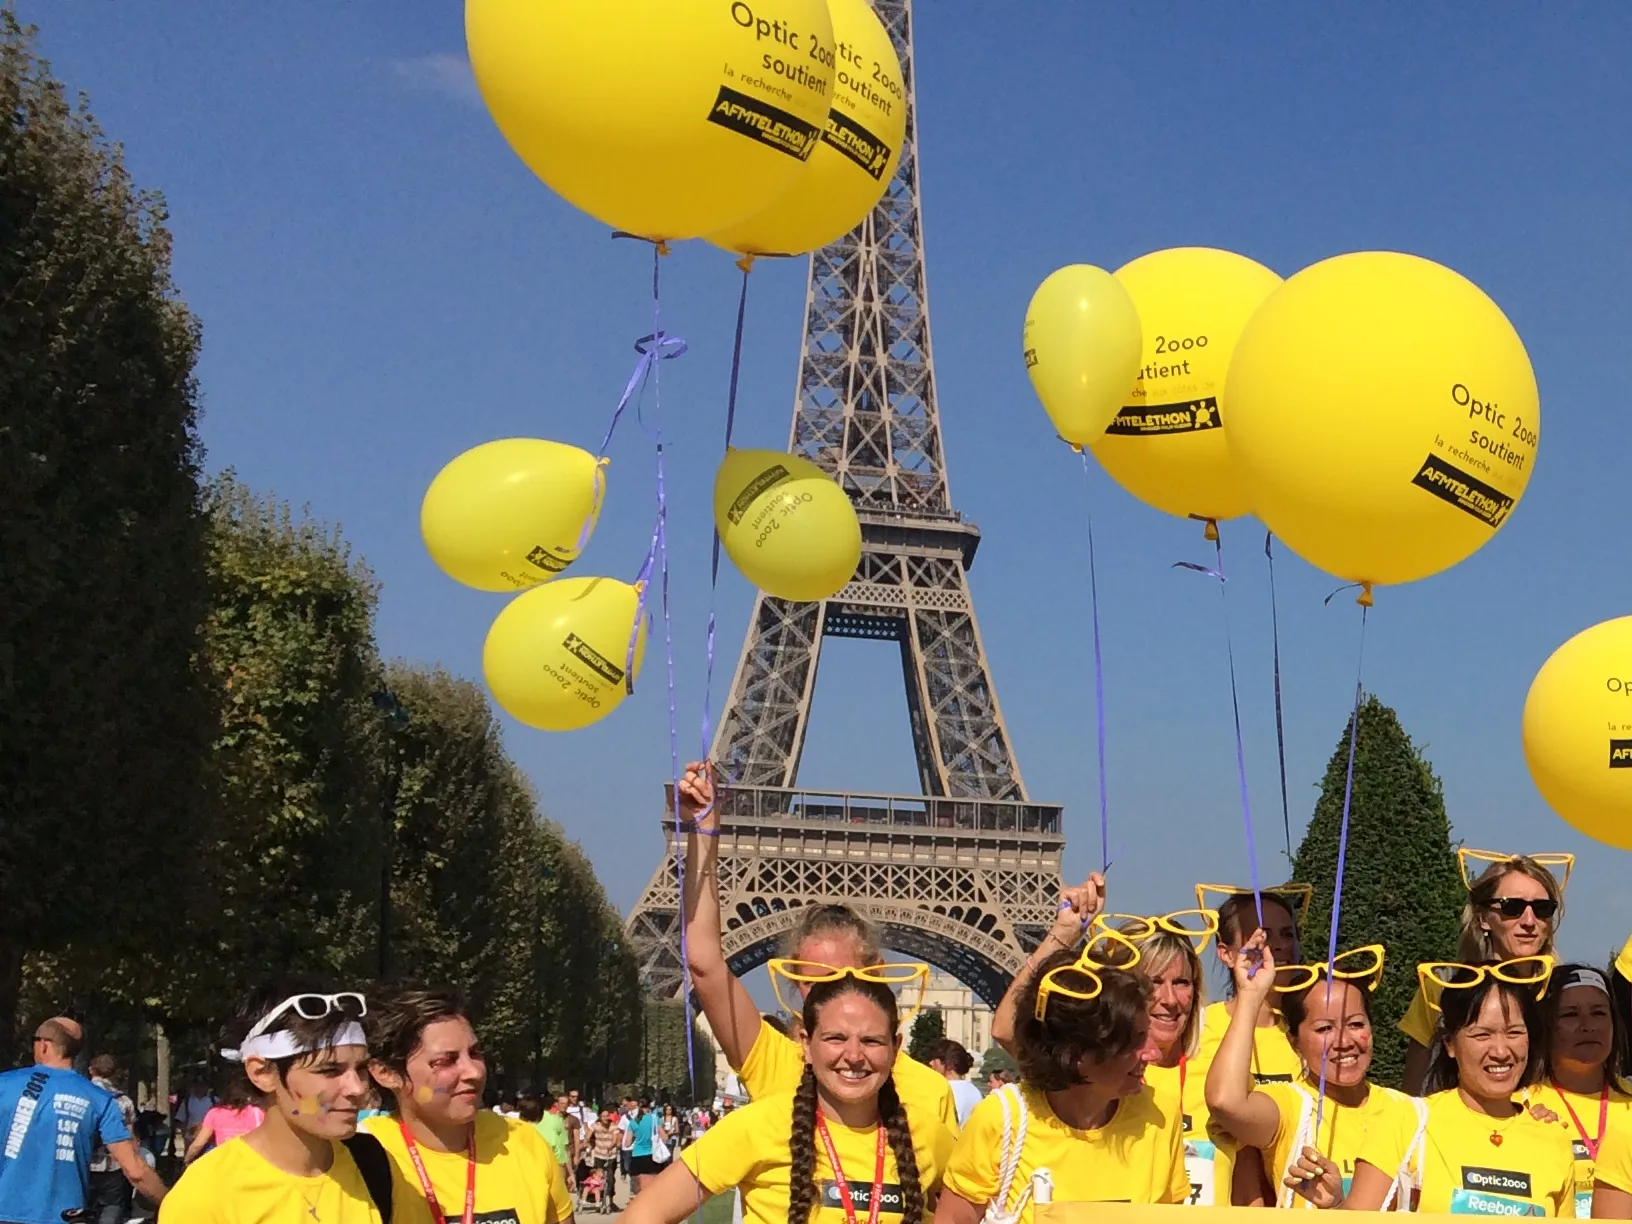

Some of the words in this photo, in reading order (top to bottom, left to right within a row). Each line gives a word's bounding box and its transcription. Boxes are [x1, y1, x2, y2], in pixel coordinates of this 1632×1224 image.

[731, 2, 799, 50] Optic
[723, 63, 734, 77] la
[741, 73, 792, 102] recherche
[762, 54, 827, 96] soutient
[835, 42, 862, 69] tic
[872, 62, 902, 100] 2000
[838, 71, 892, 116] outient
[1155, 335, 1208, 354] 2000
[1137, 359, 1191, 381] utient
[1452, 383, 1506, 430] Optic
[1512, 416, 1537, 448] 2000
[1434, 434, 1444, 448] la
[1448, 444, 1491, 474] recherche
[1469, 430, 1525, 471] soutient
[756, 518, 780, 548] 2000
[543, 664, 572, 689] 2000
[560, 663, 600, 693] soutient
[1608, 722, 1617, 731] la
[4, 1096, 38, 1159] FINISHER
[22, 1072, 51, 1101] 2014
[1473, 1172, 1502, 1188] Optic
[1502, 1177, 1528, 1190] 2000
[1468, 1195, 1523, 1217] Reebok
